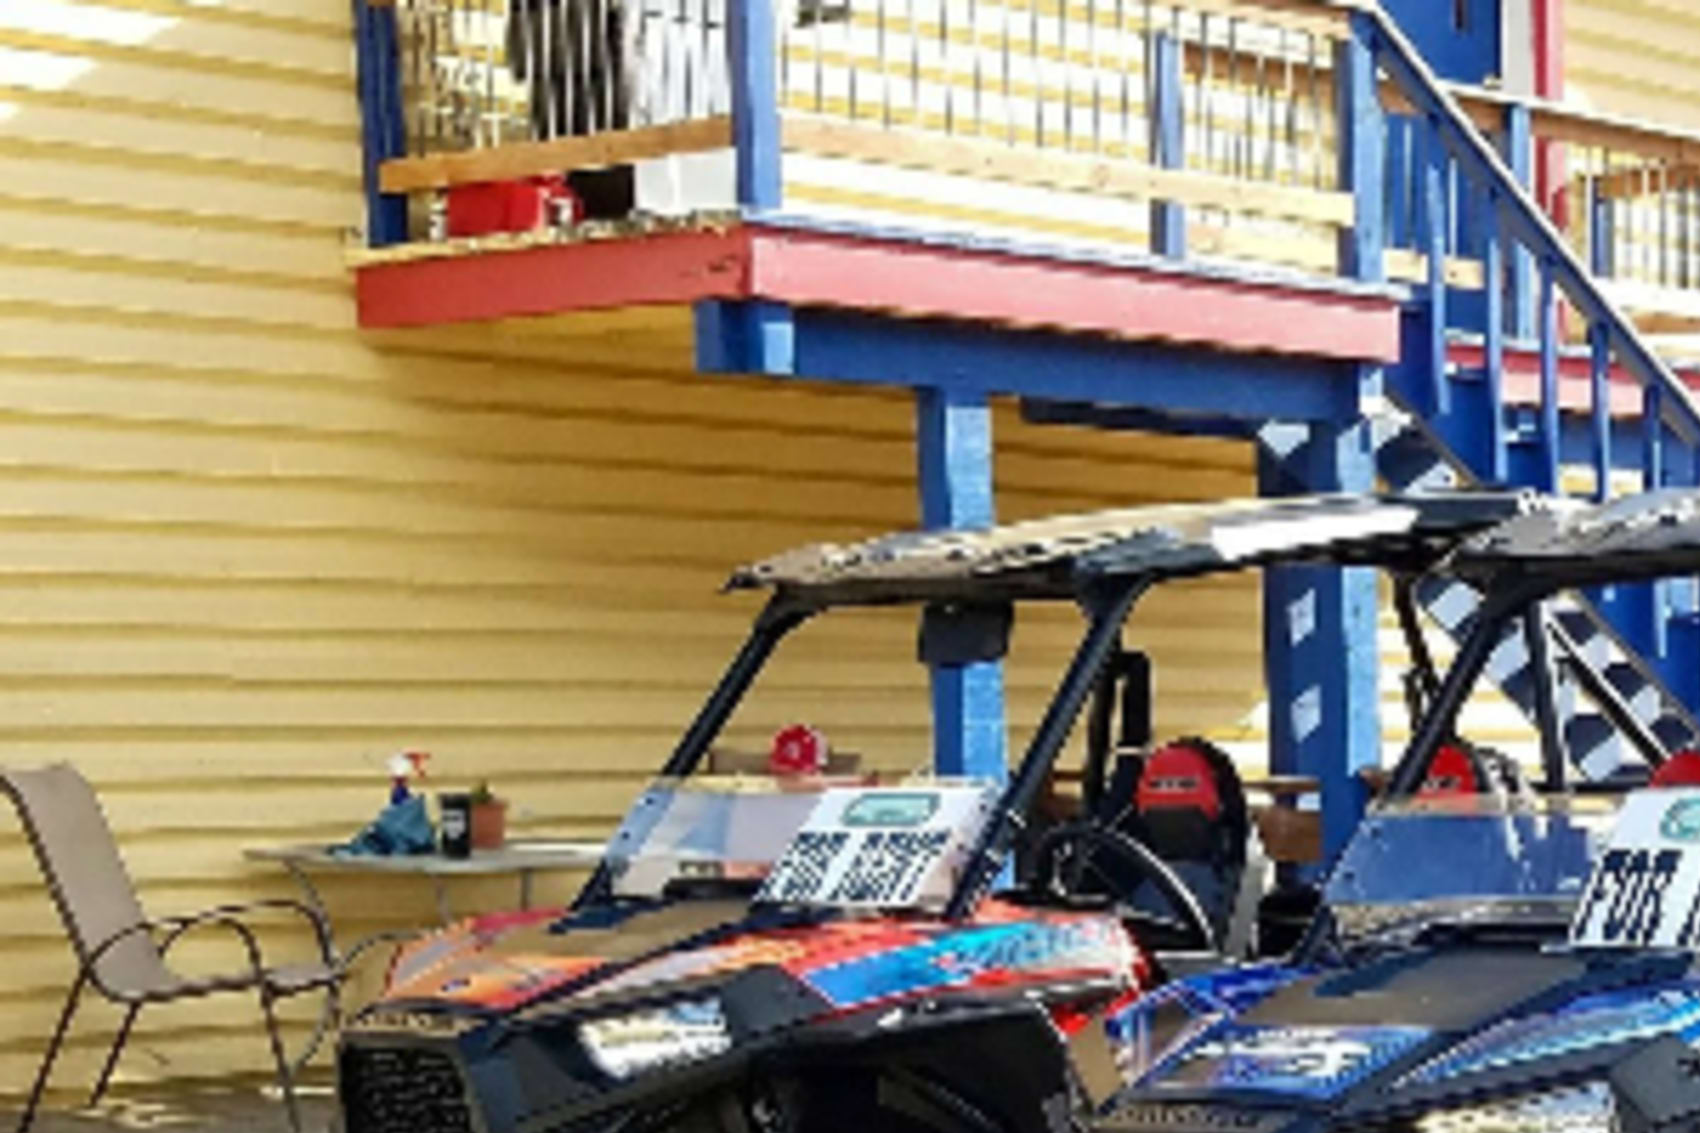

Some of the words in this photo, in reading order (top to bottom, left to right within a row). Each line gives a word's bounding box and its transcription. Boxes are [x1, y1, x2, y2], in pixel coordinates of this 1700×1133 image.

[754, 832, 850, 900] FOR
[829, 832, 948, 901] RENT
[1574, 850, 1682, 941] FOR
